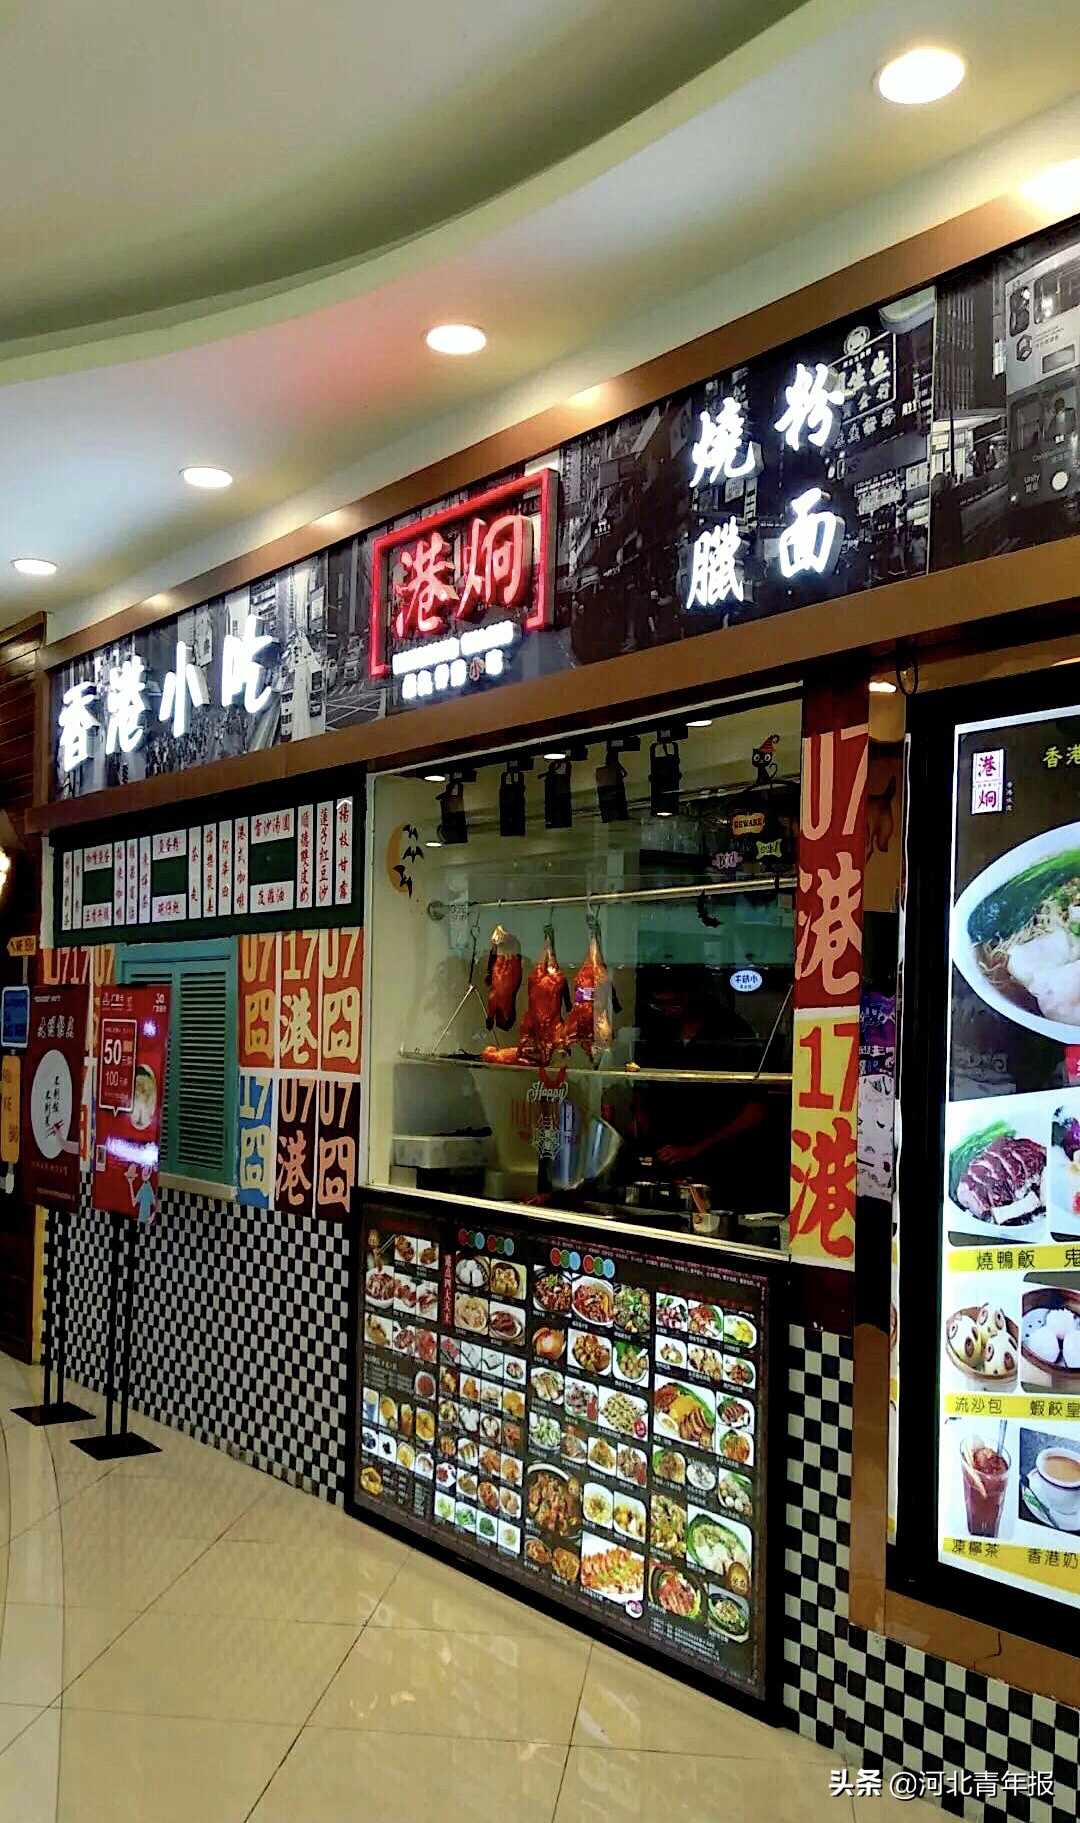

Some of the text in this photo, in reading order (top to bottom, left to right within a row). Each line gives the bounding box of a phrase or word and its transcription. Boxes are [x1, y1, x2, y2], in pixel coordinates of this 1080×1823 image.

[58, 614, 273, 773] 香港小吃
[801, 725, 868, 841] 07
[978, 755, 997, 810] 港炯
[795, 852, 863, 997] 港
[241, 933, 276, 983] 07
[283, 929, 320, 981] 17
[321, 927, 361, 980] 07
[103, 1038, 121, 1066] 50
[279, 986, 318, 1065] 港
[799, 1022, 859, 1112] 17
[239, 1075, 272, 1120] 17
[280, 1078, 316, 1124] 07
[319, 1080, 353, 1129] 07
[275, 1129, 312, 1206] 港
[790, 1117, 858, 1260] 港
[976, 1249, 1036, 1272] 燒鴨飯
[955, 1396, 1003, 1415] 流沙包
